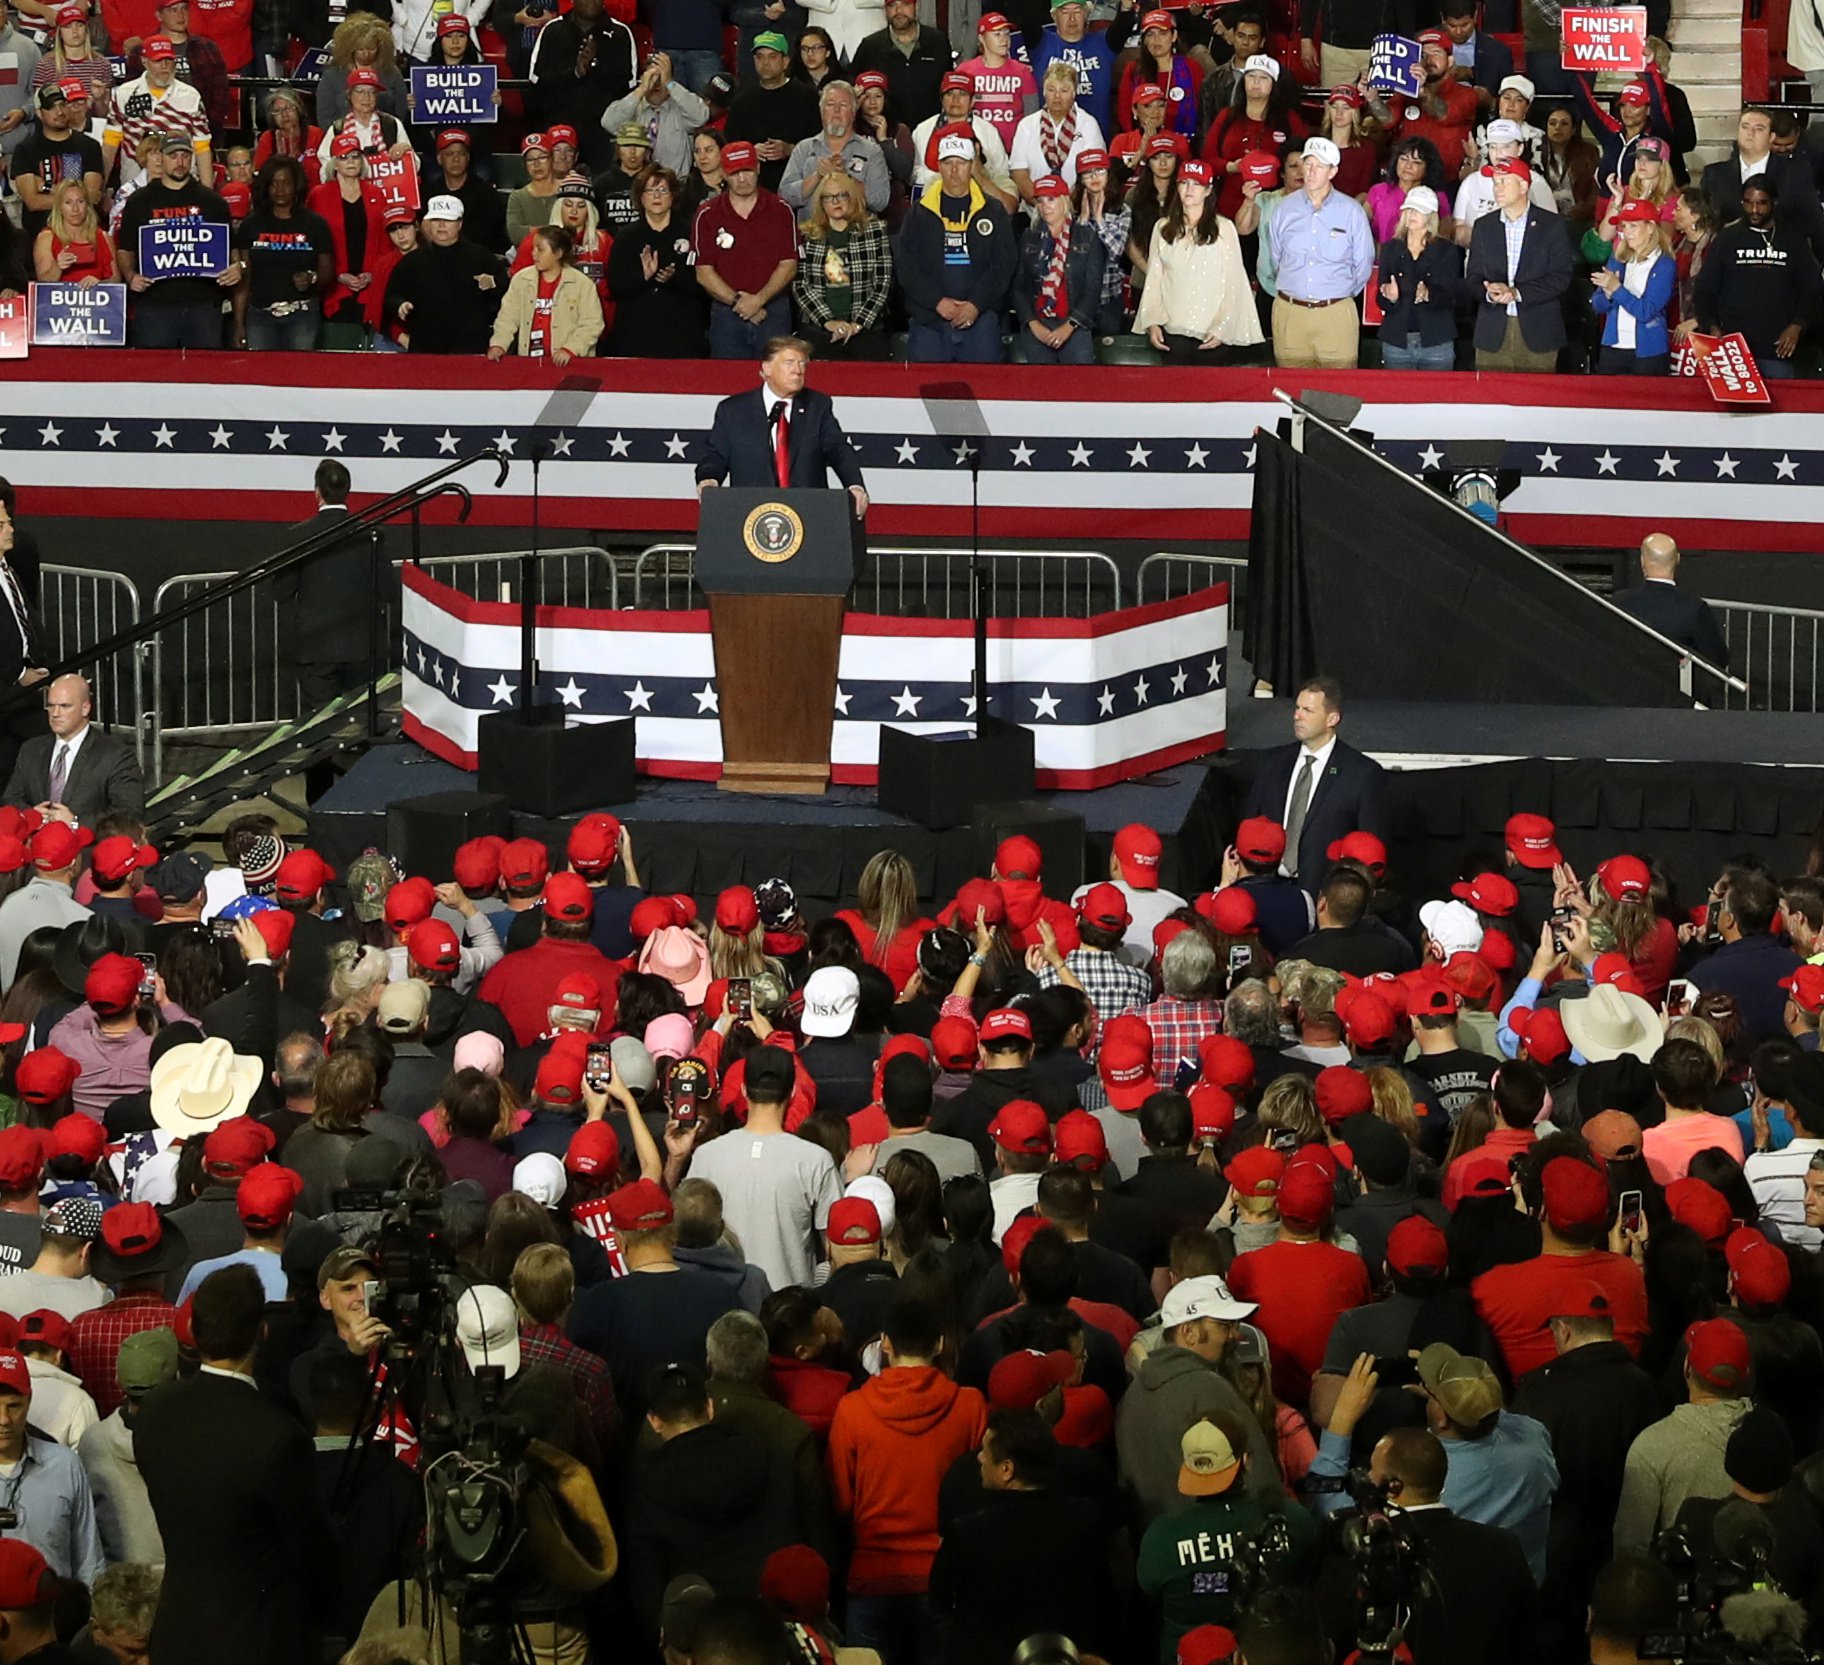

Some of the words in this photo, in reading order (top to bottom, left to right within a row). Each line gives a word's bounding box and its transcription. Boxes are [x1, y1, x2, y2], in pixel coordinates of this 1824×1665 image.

[1571, 17, 1633, 34] FINISH
[1590, 34, 1611, 44] THE
[1573, 44, 1632, 62] WALL
[425, 72, 482, 88] BUILD
[1368, 64, 1407, 86] ALL
[444, 88, 465, 98] THE
[975, 75, 1022, 94] RUMP
[424, 98, 485, 115] WALL
[153, 228, 214, 245] BUILD
[173, 242, 195, 252] THE
[1736, 249, 1789, 260] TRUMP
[152, 252, 216, 270] WALL
[50, 289, 111, 307] BUILD
[70, 307, 92, 317] THE
[49, 317, 112, 335] WALL
[1724, 339, 1751, 381] 88022
[1710, 346, 1743, 392] WALL
[812, 1002, 840, 1016] USA
[1186, 1304, 1198, 1315] 45
